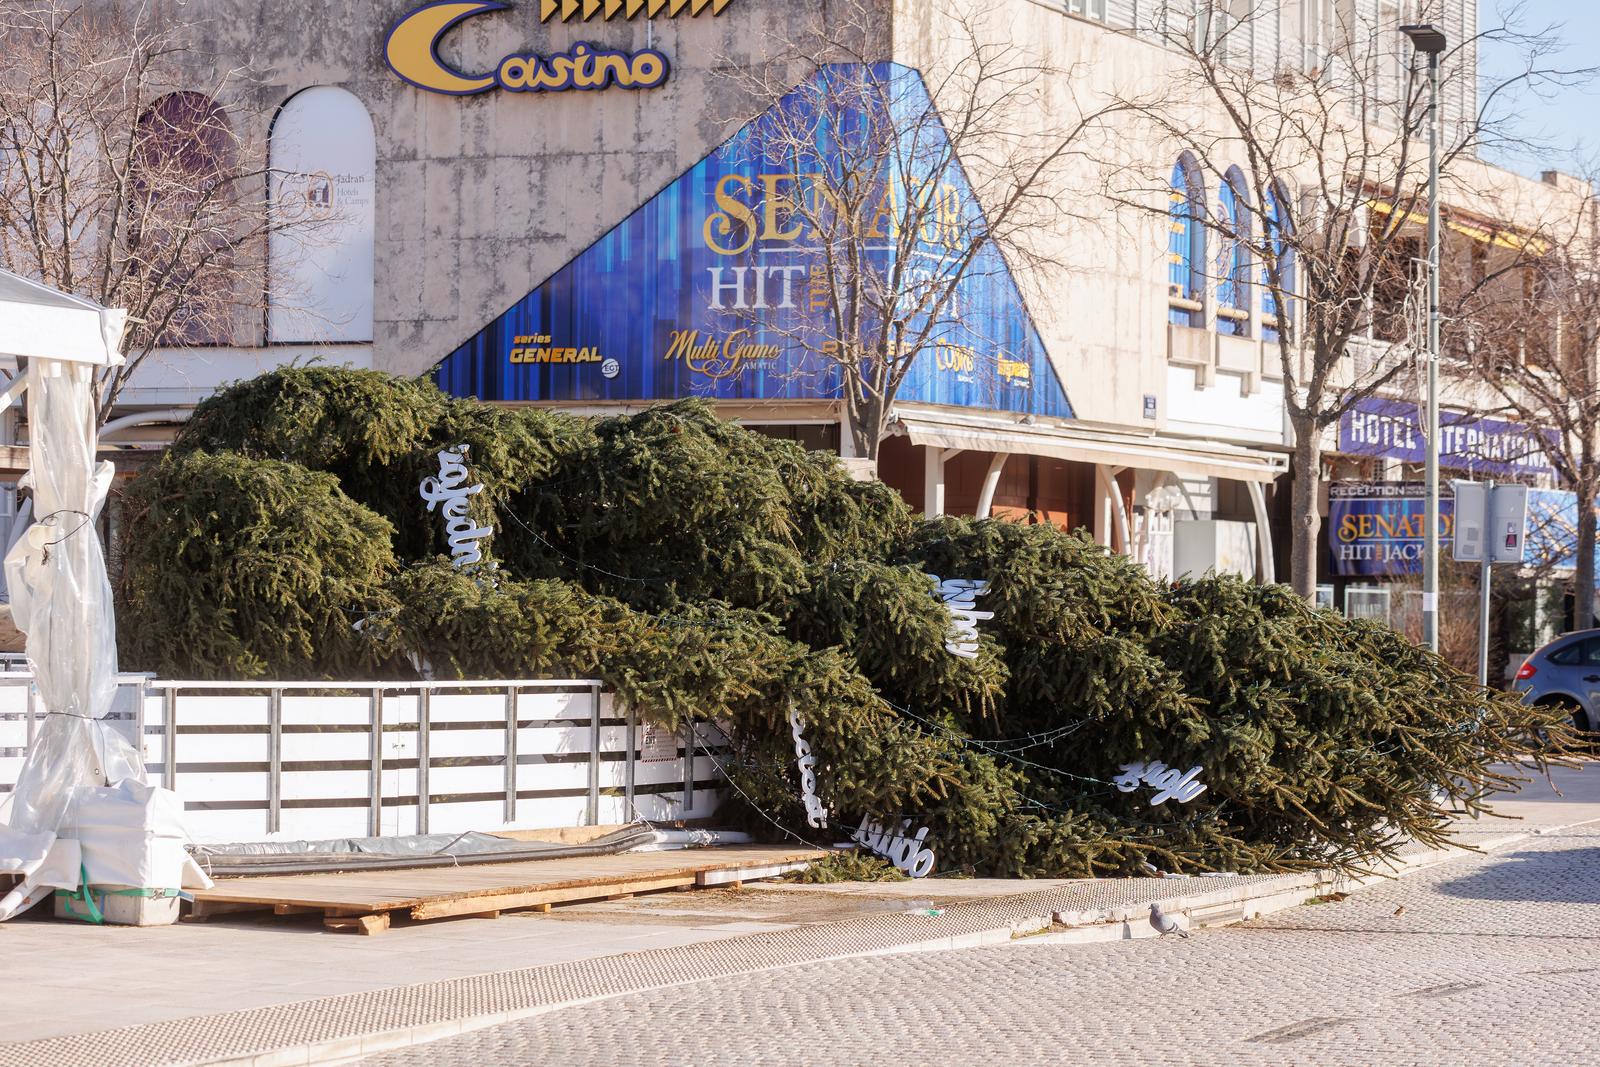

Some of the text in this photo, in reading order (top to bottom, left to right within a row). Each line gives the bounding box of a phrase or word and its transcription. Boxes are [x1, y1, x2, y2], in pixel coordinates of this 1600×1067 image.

[385, 1, 667, 94] Casino
[707, 265, 805, 309] HIT
[513, 332, 551, 344] series
[509, 347, 602, 363] GENERAL
[1351, 410, 1417, 449] HOTEL
[1330, 485, 1406, 496] RECEPTION
[1340, 544, 1375, 560] HIT
